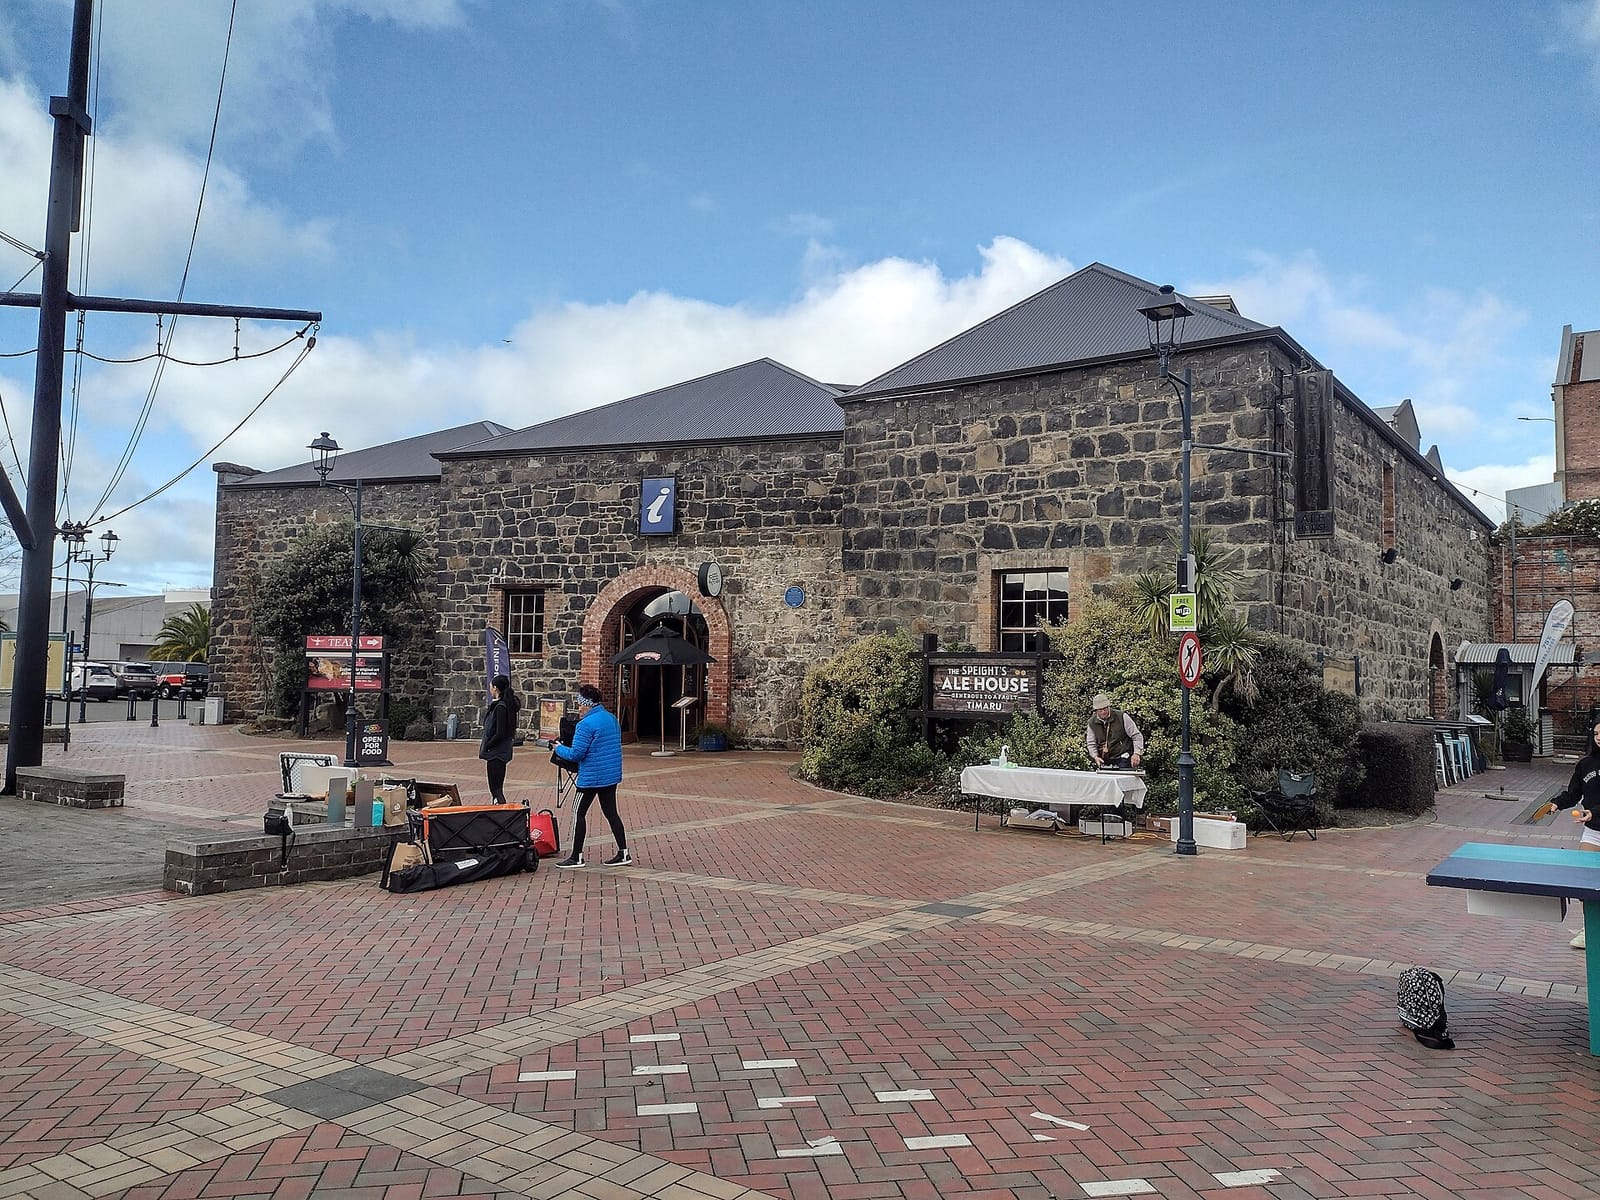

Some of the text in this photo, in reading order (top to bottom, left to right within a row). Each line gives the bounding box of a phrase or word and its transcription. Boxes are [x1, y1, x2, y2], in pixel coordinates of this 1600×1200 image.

[961, 665, 1007, 676] SPEIGHT'S
[941, 677, 1029, 692] ALE HOUSE
[966, 701, 1002, 711] TIMARU
